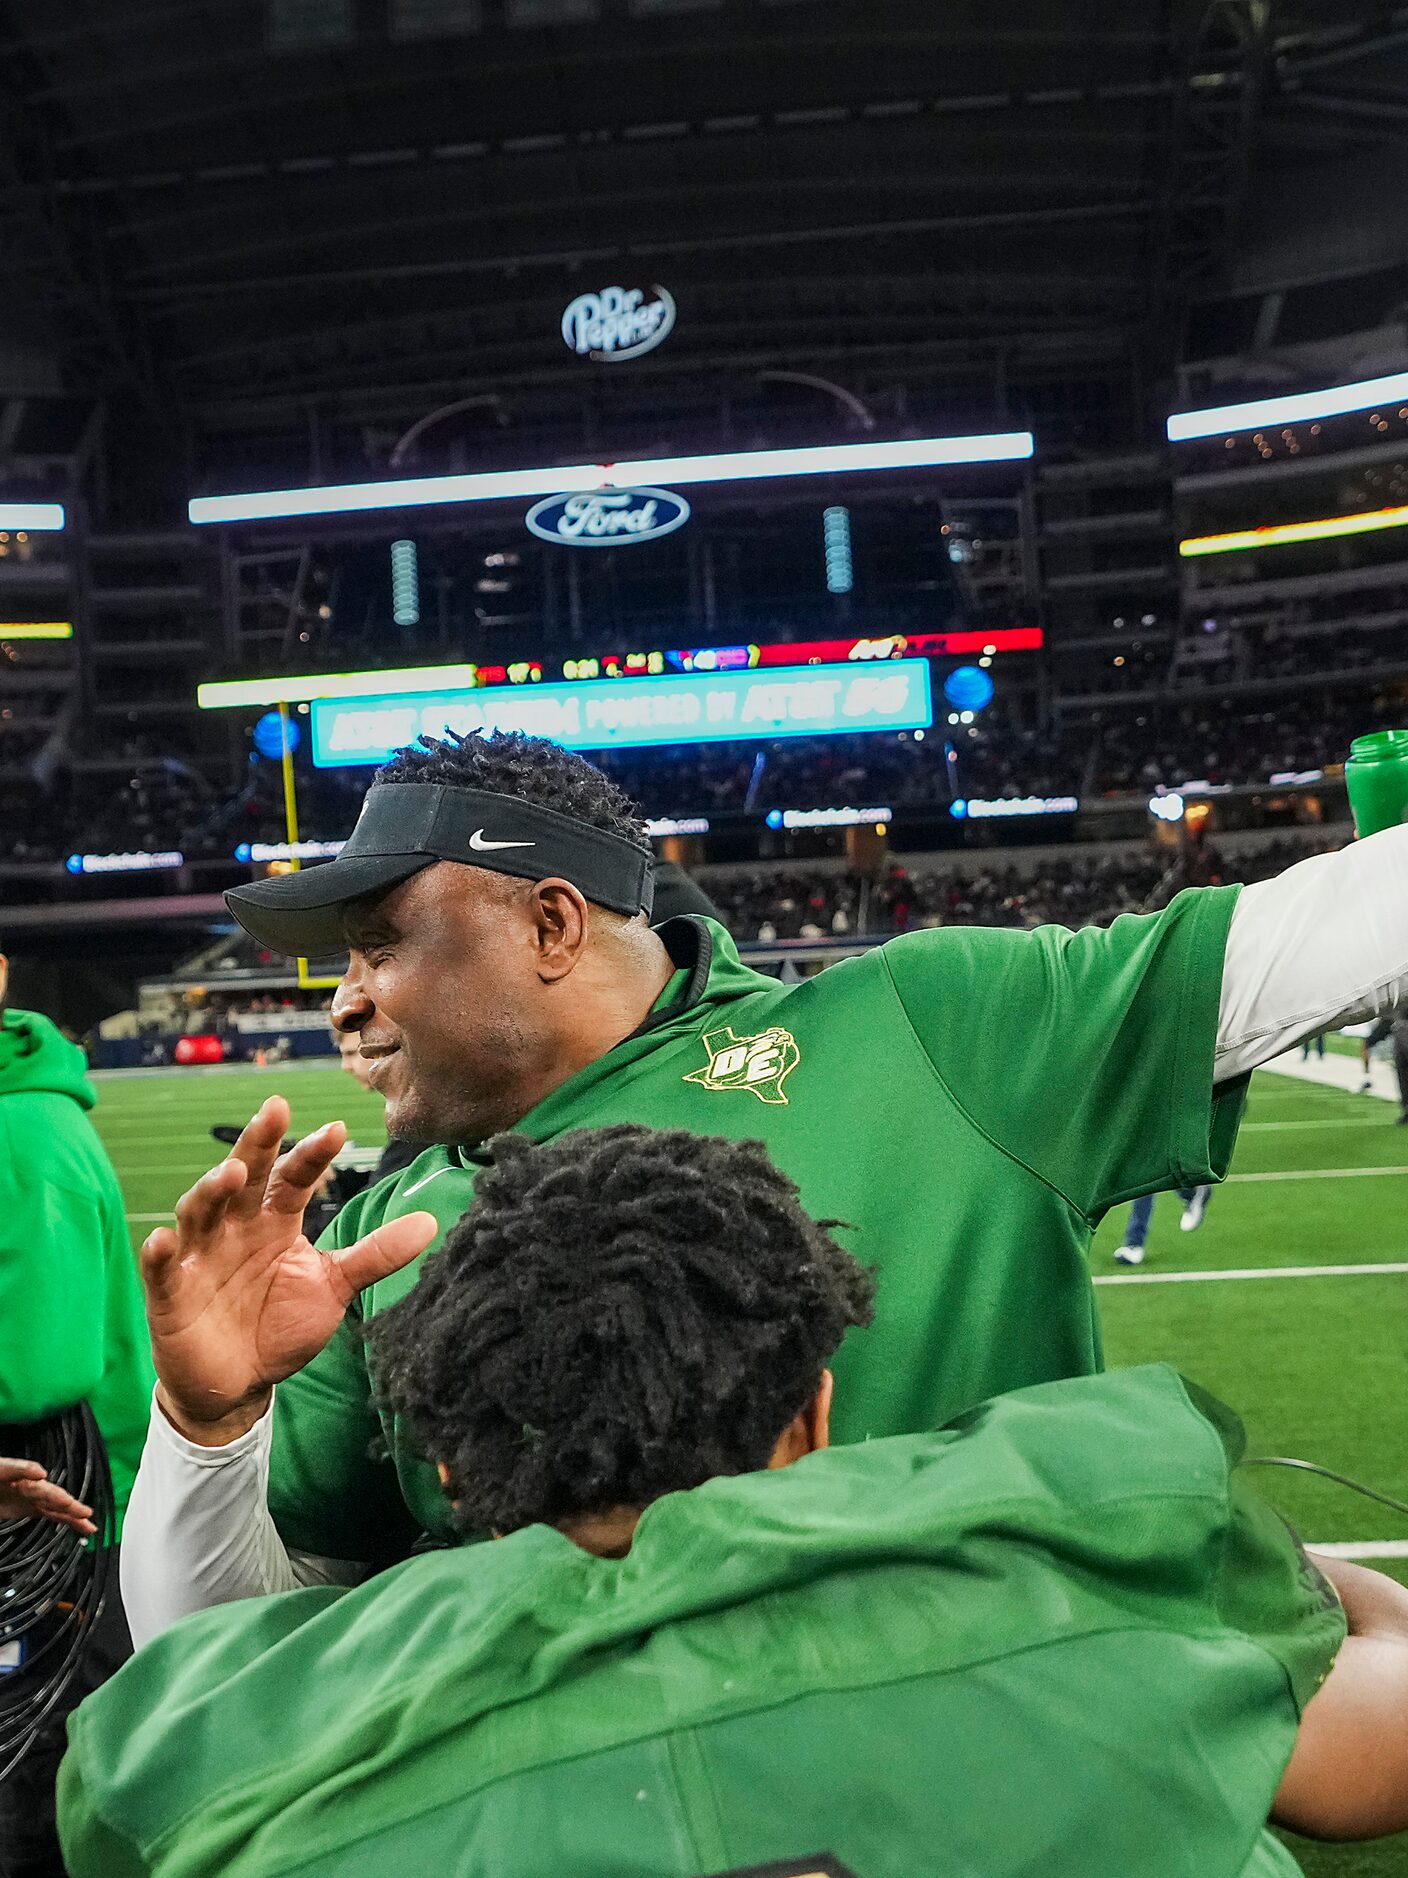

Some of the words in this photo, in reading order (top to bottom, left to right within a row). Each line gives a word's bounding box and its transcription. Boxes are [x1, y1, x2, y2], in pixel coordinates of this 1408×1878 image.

[574, 293, 665, 354] Pepper
[600, 285, 644, 320] Dr
[557, 494, 658, 537] Ford
[585, 692, 701, 729] POWERED
[741, 680, 842, 722] AT&T
[711, 1045, 781, 1083] DE
